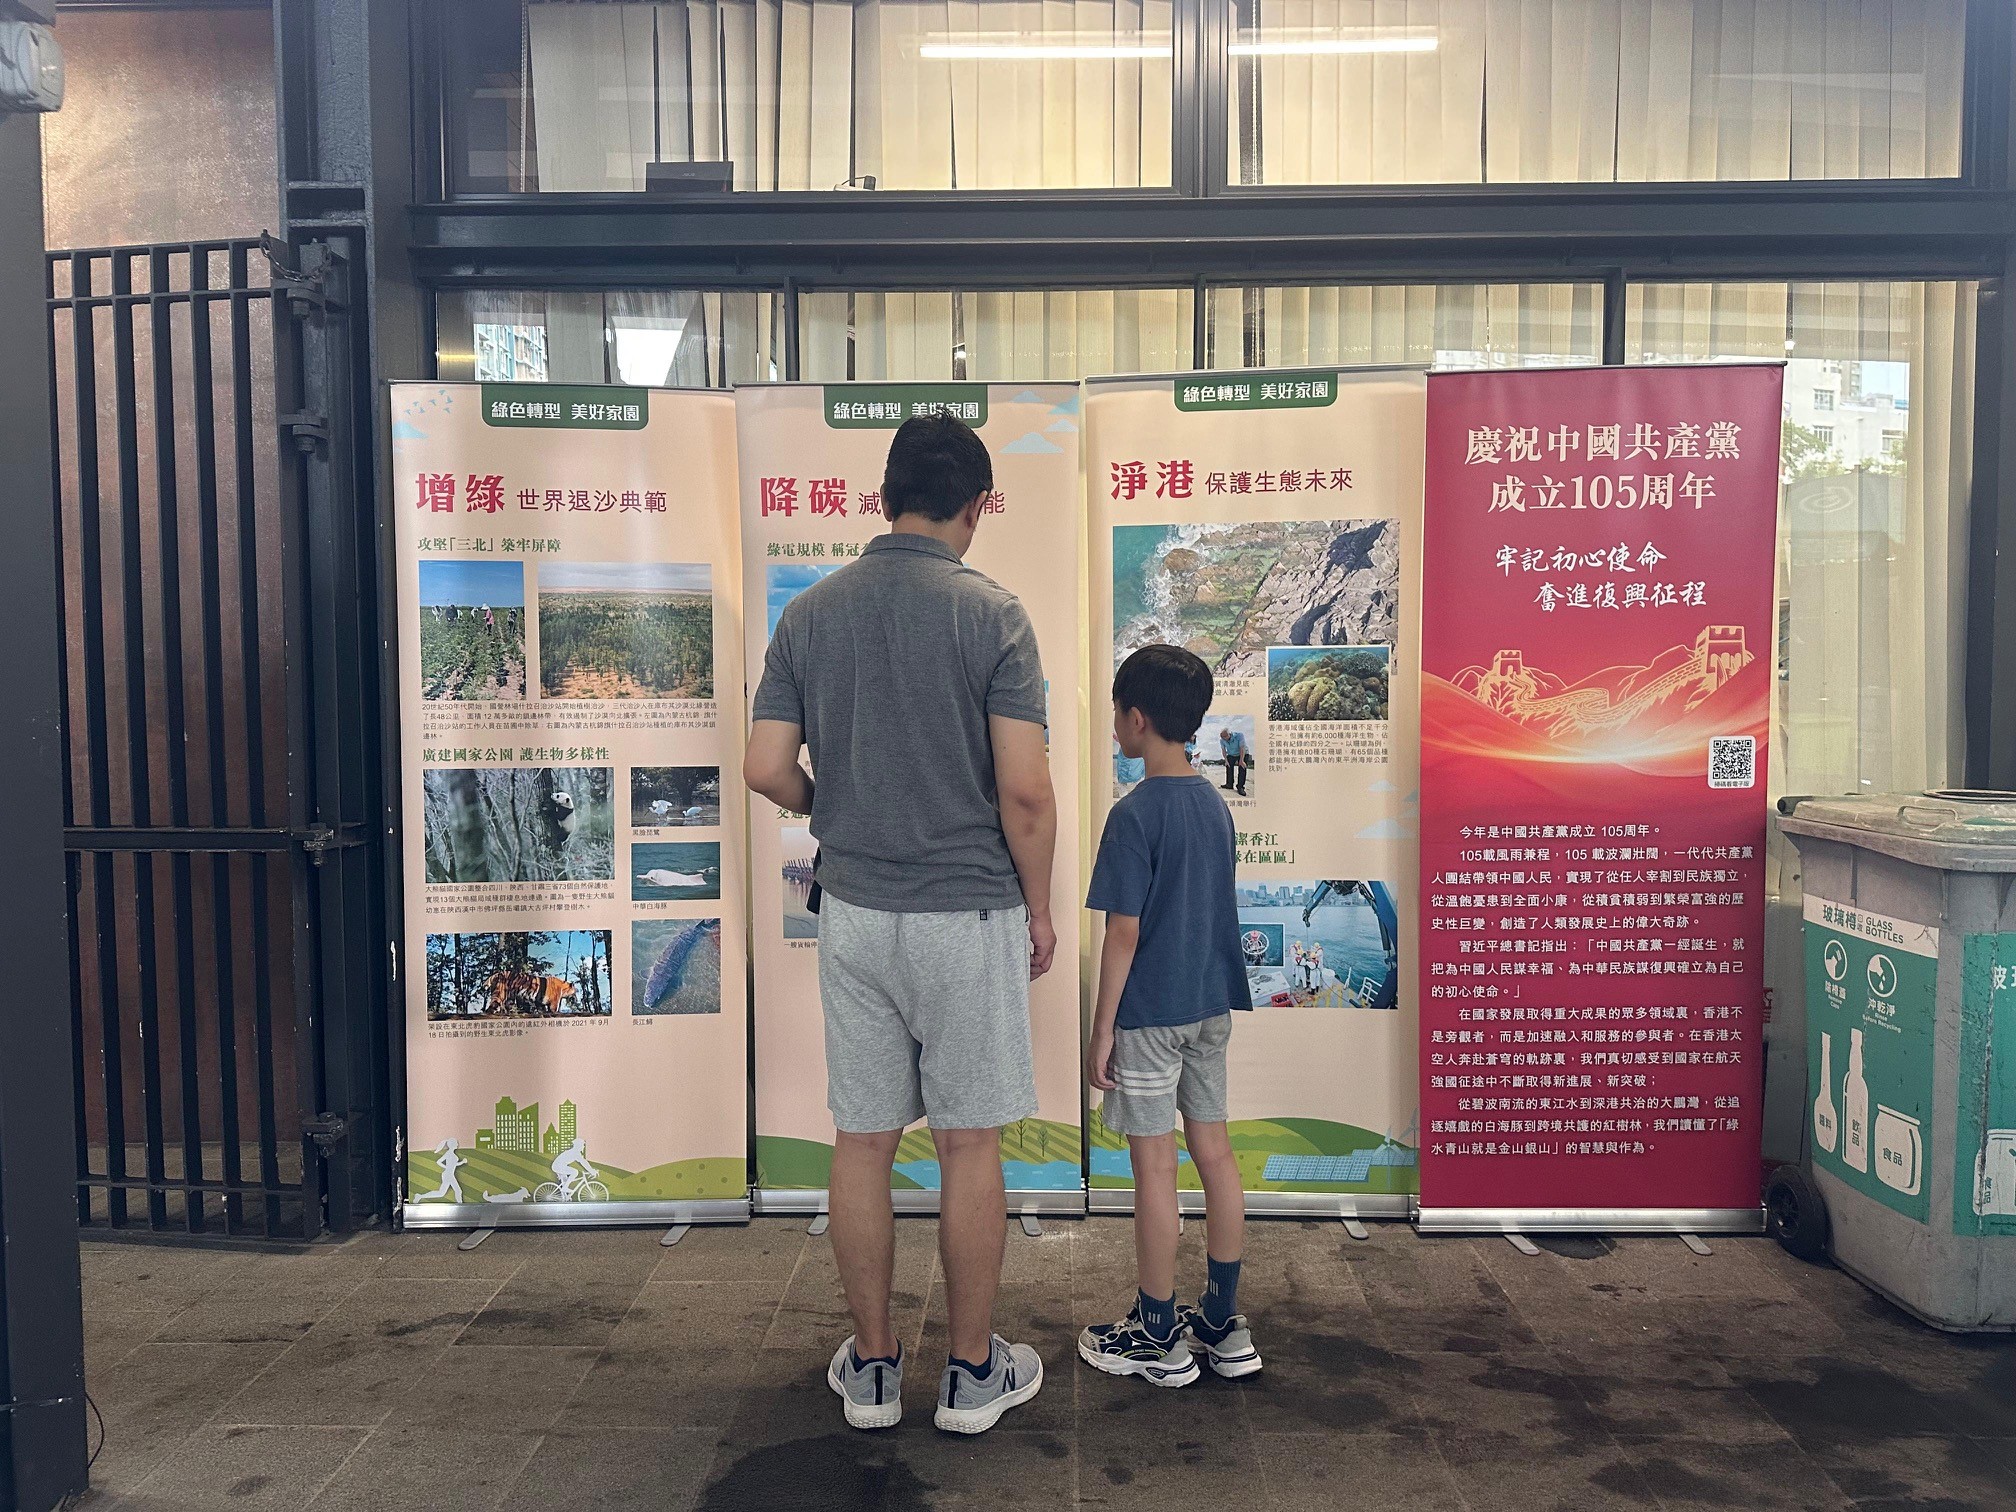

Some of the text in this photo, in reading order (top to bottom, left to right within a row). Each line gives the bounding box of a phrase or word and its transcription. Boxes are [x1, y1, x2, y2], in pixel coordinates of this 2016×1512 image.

[1183, 382, 1329, 403] 綠色轉型 美好家園
[491, 401, 640, 422] 綠色轉型 美好家園
[833, 402, 902, 420] 綠色轉型
[1464, 421, 1742, 466] 慶祝中國共產黨
[1110, 460, 1353, 500] 淨港 保護生態未來
[415, 472, 668, 514] 增綠 世界退沙典範
[760, 476, 848, 518] 降碳
[1487, 470, 1717, 514] 成立105周年
[501, 538, 561, 553] 築牢屏障
[766, 542, 826, 558] 綠電規模
[1495, 541, 1668, 577] 牢記初心使命
[1533, 580, 1707, 612] 奮進復興征程
[422, 746, 610, 761] 廣建國家公園 護生物多樣性
[1460, 824, 1661, 839] 今年是中國共產黨成立 105周年。
[1822, 904, 1856, 931] 玻璃樽
[1866, 916, 1893, 932] GLASS
[1866, 926, 1904, 944] BOTTLES
[1431, 985, 1520, 998] 的初心使命。」
[1882, 1147, 1903, 1166] 食品
